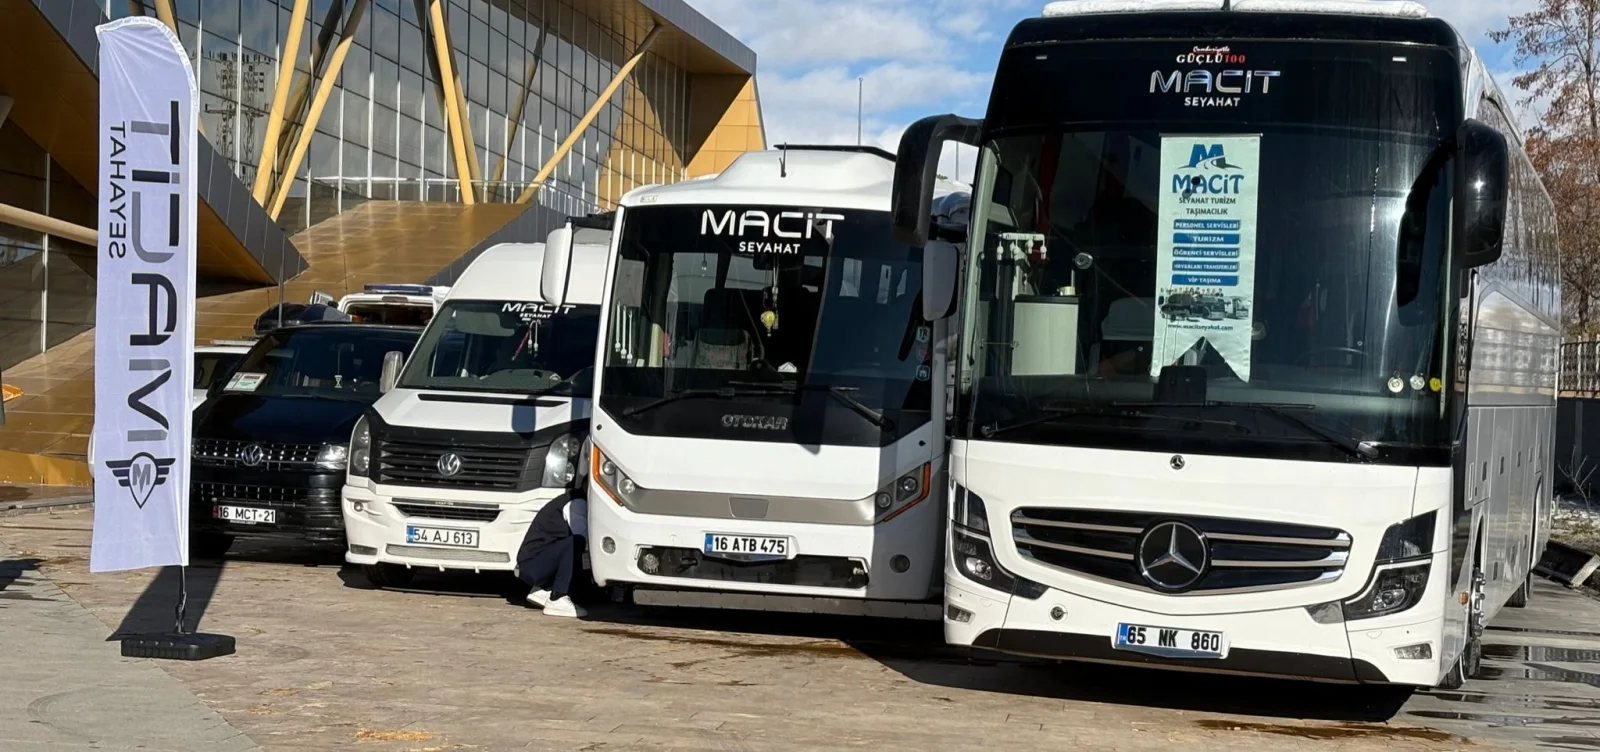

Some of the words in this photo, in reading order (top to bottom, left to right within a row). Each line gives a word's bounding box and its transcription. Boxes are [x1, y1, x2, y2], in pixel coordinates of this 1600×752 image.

[1184, 97, 1240, 107] SEYAHAT
[1211, 196, 1236, 204] TURİZM
[1186, 208, 1228, 216] TAŞIMACILIK
[738, 241, 800, 254] SEYAHAT
[721, 414, 788, 430] OTOKAR
[220, 506, 229, 518] 16
[235, 508, 258, 520] MCT
[264, 510, 275, 522] 21
[414, 528, 428, 541] 54
[433, 530, 449, 543] AJ
[453, 531, 472, 544] 613
[715, 536, 728, 551] 16
[732, 537, 757, 552] ATB
[760, 539, 785, 553] 475
[1127, 626, 1147, 644] 65
[1158, 628, 1178, 647] NK
[1191, 632, 1220, 651] 860
